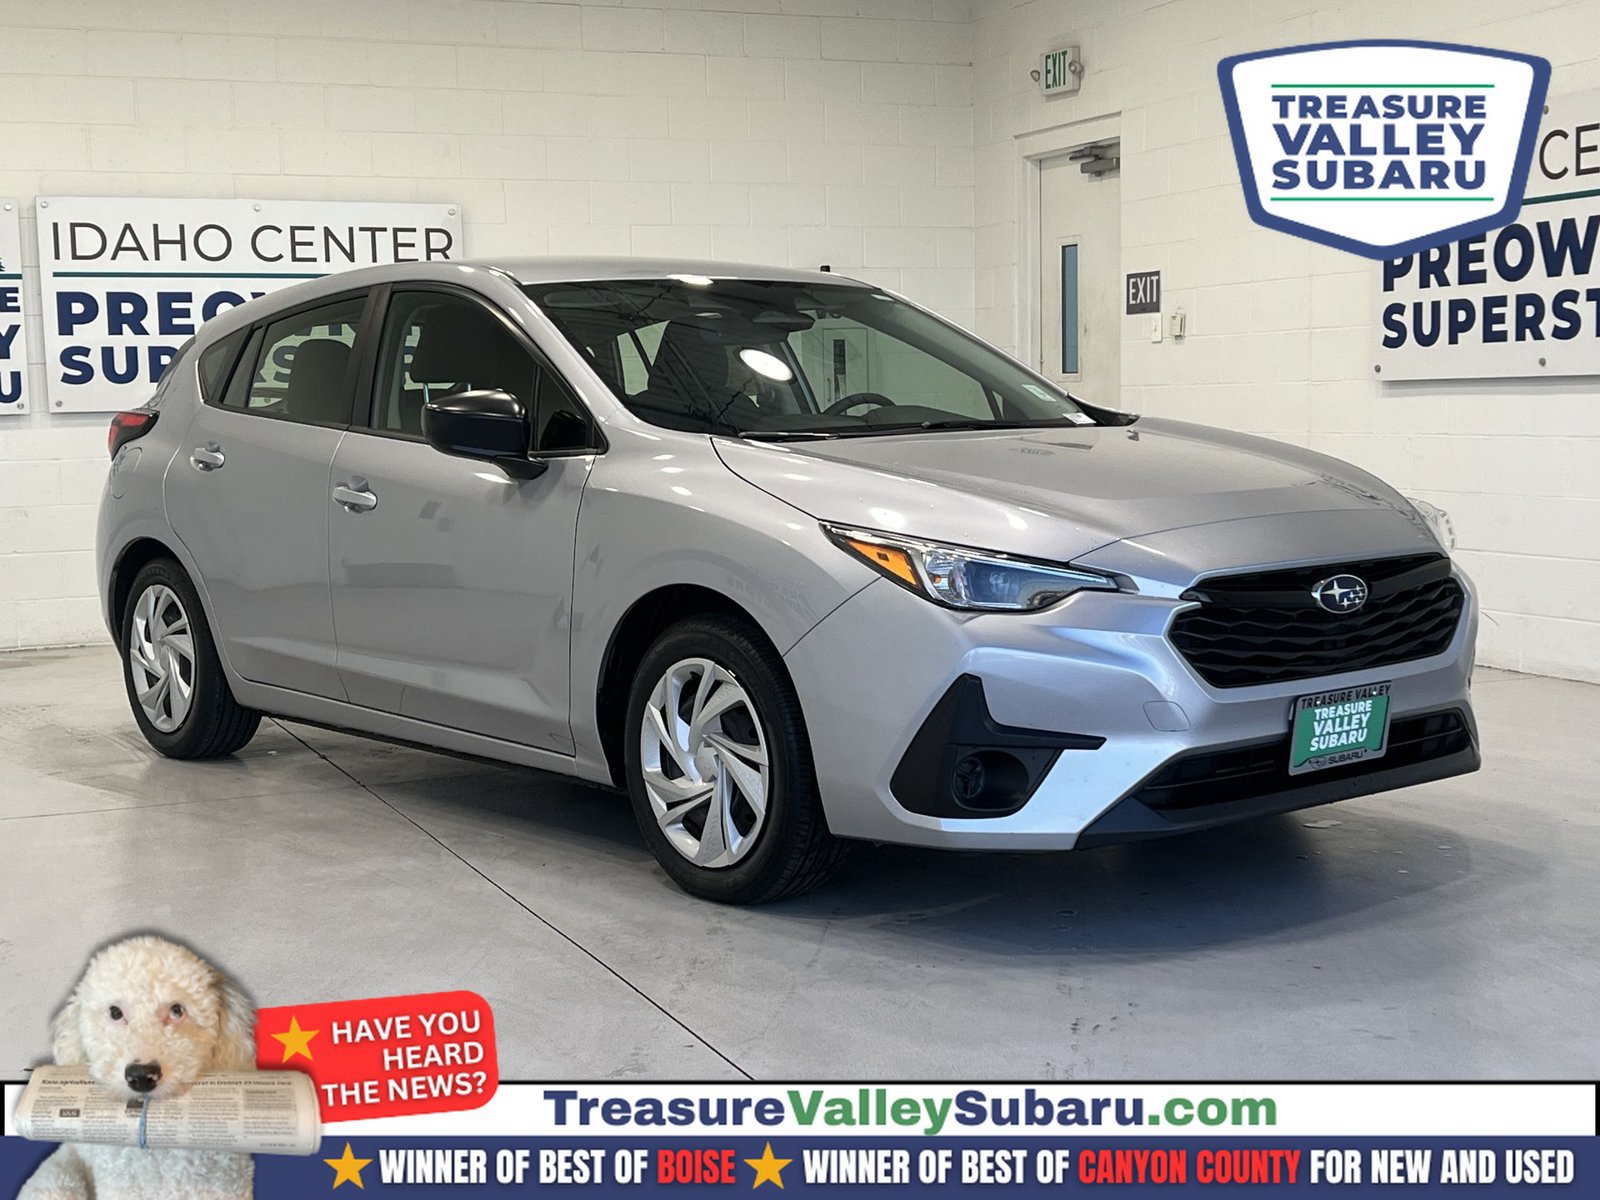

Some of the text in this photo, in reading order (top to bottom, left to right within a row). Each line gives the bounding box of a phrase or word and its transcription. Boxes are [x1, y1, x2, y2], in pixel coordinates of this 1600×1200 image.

[1045, 50, 1068, 89] EXIT
[52, 222, 453, 263] IDAHO CENTER
[1129, 275, 1159, 304] EXIT
[1301, 683, 1392, 709] TREASURE VALLEY
[1314, 700, 1373, 721] TREASURE
[1313, 712, 1371, 737] VALLEY
[1309, 728, 1368, 752] SUBARU
[1328, 751, 1364, 764] SUBARU
